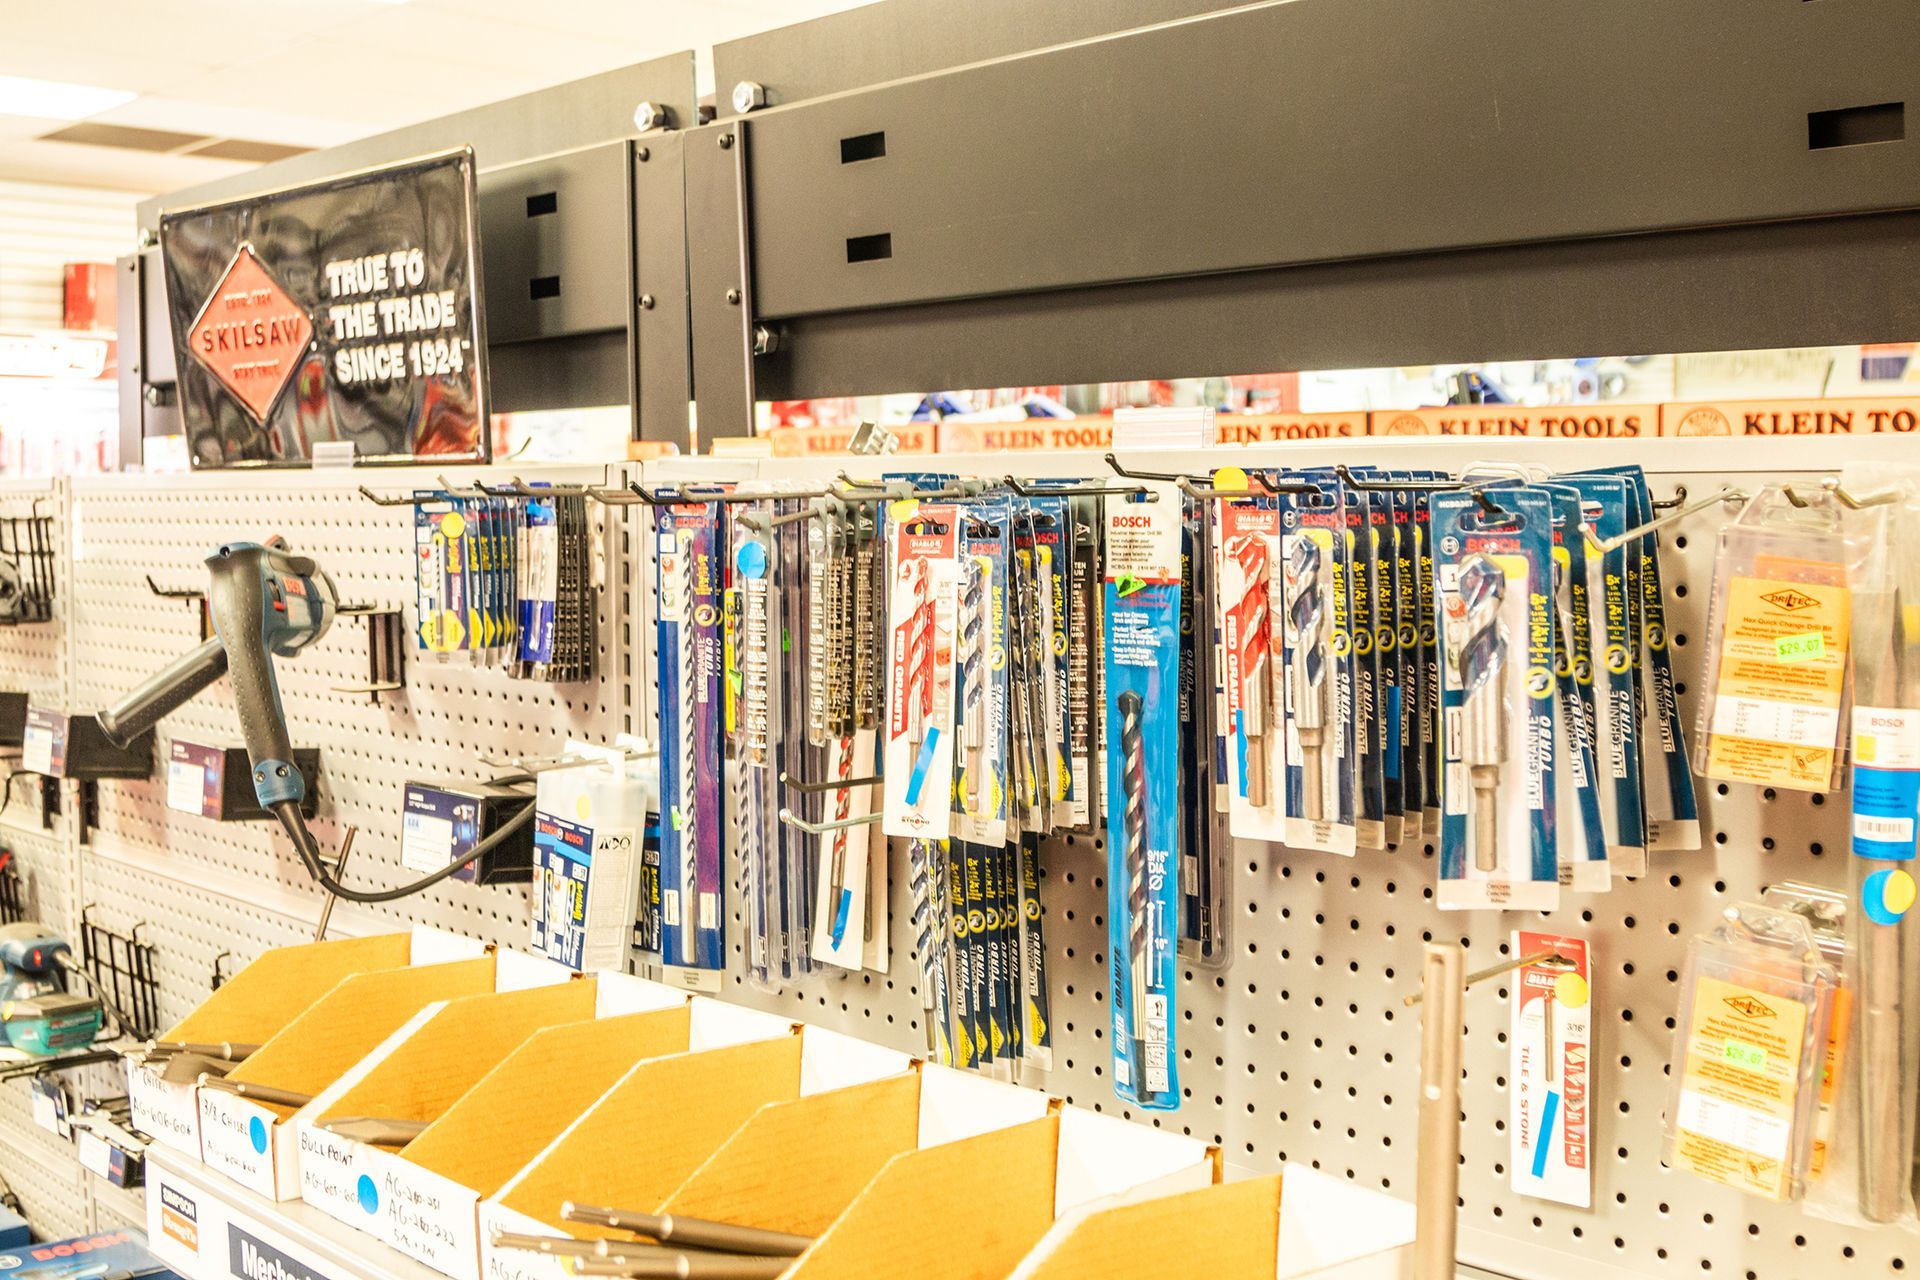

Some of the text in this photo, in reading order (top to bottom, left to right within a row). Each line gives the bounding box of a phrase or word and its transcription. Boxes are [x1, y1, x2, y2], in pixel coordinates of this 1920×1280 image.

[326, 248, 425, 298] TRUE TO
[329, 290, 456, 340] THE TRADE
[202, 313, 302, 353] SKILSAW
[335, 336, 464, 383] SINCE 1924
[1216, 421, 1352, 444] EIN TOOLS
[1439, 415, 1641, 437] KLEIN TOOLS
[1743, 412, 1854, 435] KLEIN
[984, 430, 1048, 449] KLEIN
[674, 516, 709, 529] BOSCH
[1112, 516, 1151, 528] BOSCH
[1301, 513, 1339, 527] BOSCH
[971, 543, 1002, 555] BOSCH
[1036, 532, 1059, 544] OSCH
[1466, 537, 1521, 553] BOSCH
[1353, 561, 1366, 572] 5x
[1377, 559, 1390, 570] 5x
[1399, 557, 1411, 568] 5x
[1421, 556, 1432, 567] 5x
[1401, 585, 1413, 596] 2x
[1422, 584, 1433, 594] 2x
[1573, 584, 1585, 596] 5x
[1606, 574, 1621, 586] 5x
[1645, 583, 1657, 594] 2x
[1355, 590, 1367, 601] 2x
[1379, 588, 1391, 599] 2x
[1530, 592, 1548, 606] 5x
[1576, 614, 1587, 626] 2x
[1608, 604, 1623, 617] 2x
[1758, 618, 1777, 626] Quick
[1779, 620, 1805, 630] Change
[706, 637, 714, 677] TURBO
[1778, 638, 1820, 656] $29.07
[697, 637, 706, 703] BLUEGRANITE
[893, 629, 905, 732] RED GRANITE
[1227, 615, 1239, 725] RED GRANITE
[1341, 672, 1352, 724] TURBO
[1363, 670, 1374, 721] TURBO
[1407, 665, 1416, 714] TURBO
[1429, 662, 1438, 711] TURBO
[1661, 666, 1676, 718] TURBO
[1570, 693, 1588, 749] TURBO
[1620, 690, 1632, 743] TURBO
[1652, 666, 1673, 753] BLUEGRANITE
[1585, 702, 1596, 756] TURBO
[1608, 690, 1624, 779] BLUEGRANITE
[1539, 715, 1552, 772] TURBO
[1560, 695, 1585, 789] BLUEGRANITE
[1527, 715, 1541, 810] BLUEGRANITE
[564, 832, 584, 847] BOSCH
[1147, 850, 1169, 863] 9/16"
[1148, 862, 1167, 875] DIA.
[1034, 932, 1042, 971] TURBO
[1154, 937, 1169, 951] 10"
[962, 949, 970, 991] TURBO
[977, 944, 985, 986] TURBO
[991, 942, 1000, 982] TURBO
[1114, 946, 1123, 1009] GRANITE
[1527, 973, 1559, 987] DIAB
[993, 1024, 1001, 1051] TOUGH
[1520, 1046, 1530, 1150] TILE & STONE
[221, 1112, 249, 1136] CHISEL
[301, 1131, 354, 1167] BULL POINT
[161, 1186, 196, 1219] SIMPSON
[240, 1239, 311, 1280] Mech
